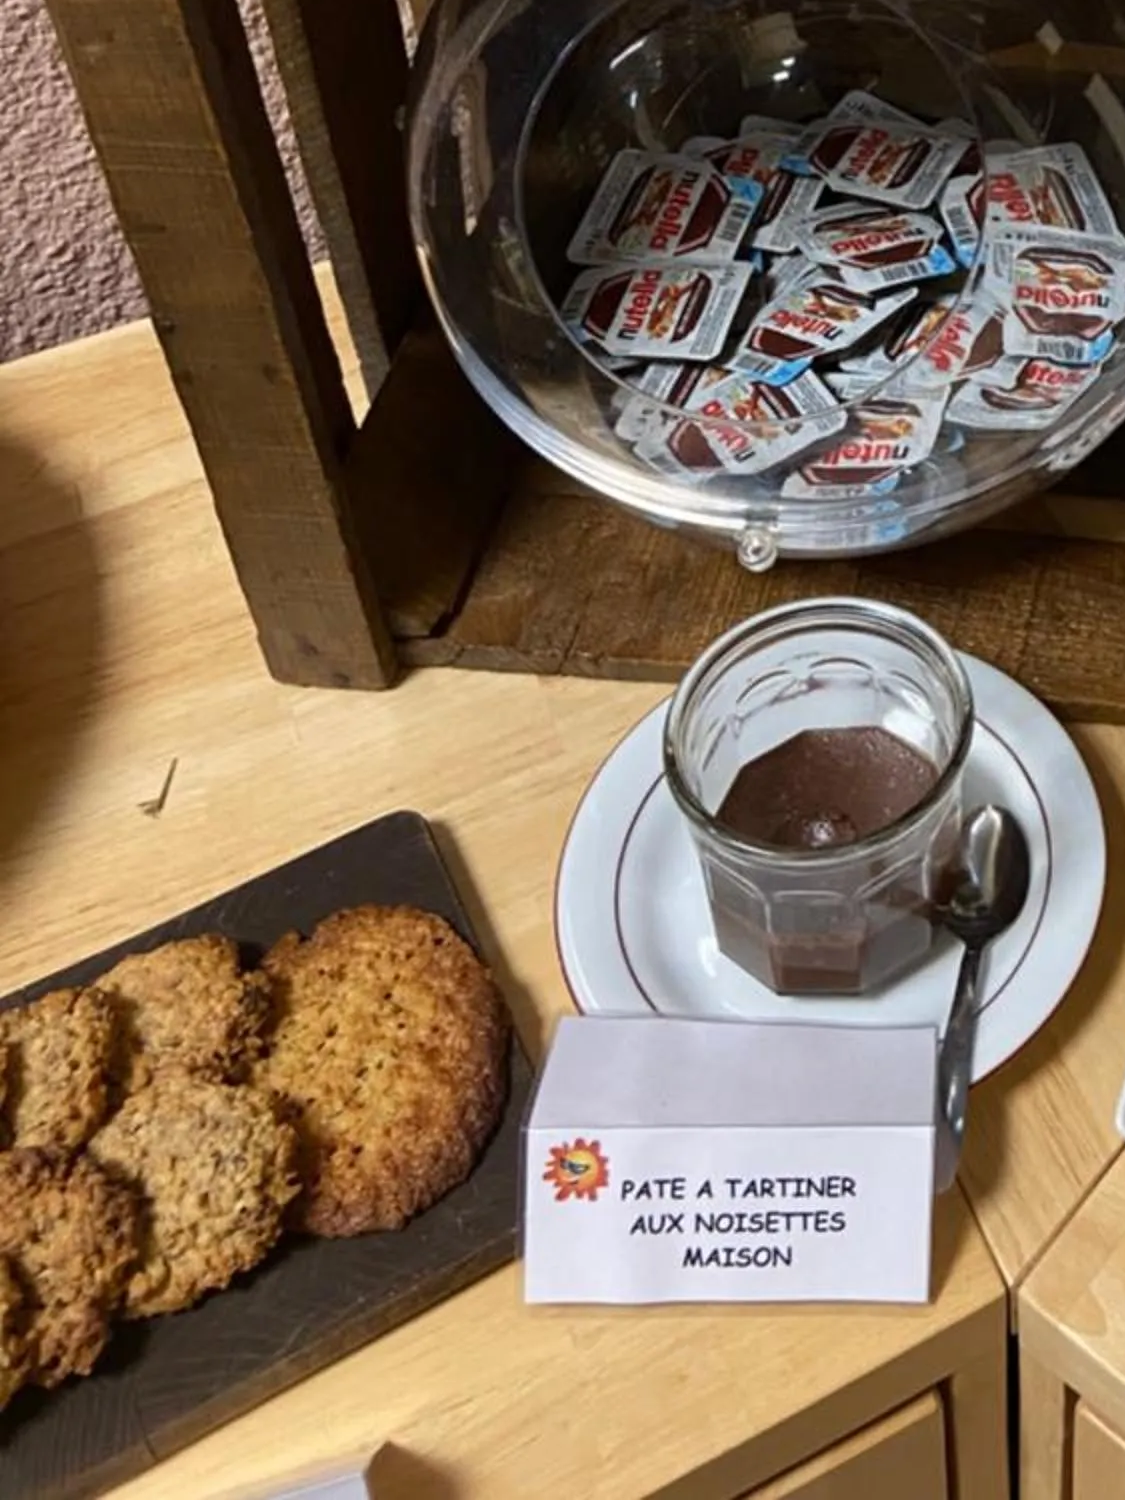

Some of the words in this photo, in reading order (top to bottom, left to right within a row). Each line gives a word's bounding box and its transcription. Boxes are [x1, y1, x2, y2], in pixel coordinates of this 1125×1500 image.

[649, 169, 701, 253] nutella
[617, 269, 662, 340] nutella
[1016, 284, 1110, 308] nutella
[764, 309, 846, 342] nutella
[620, 1178, 687, 1201] PATE
[696, 1179, 713, 1199] A
[725, 1175, 857, 1199] TARTINER
[629, 1213, 686, 1236] AUX
[694, 1211, 847, 1234] NOISETTES
[681, 1245, 794, 1269] MAISON
